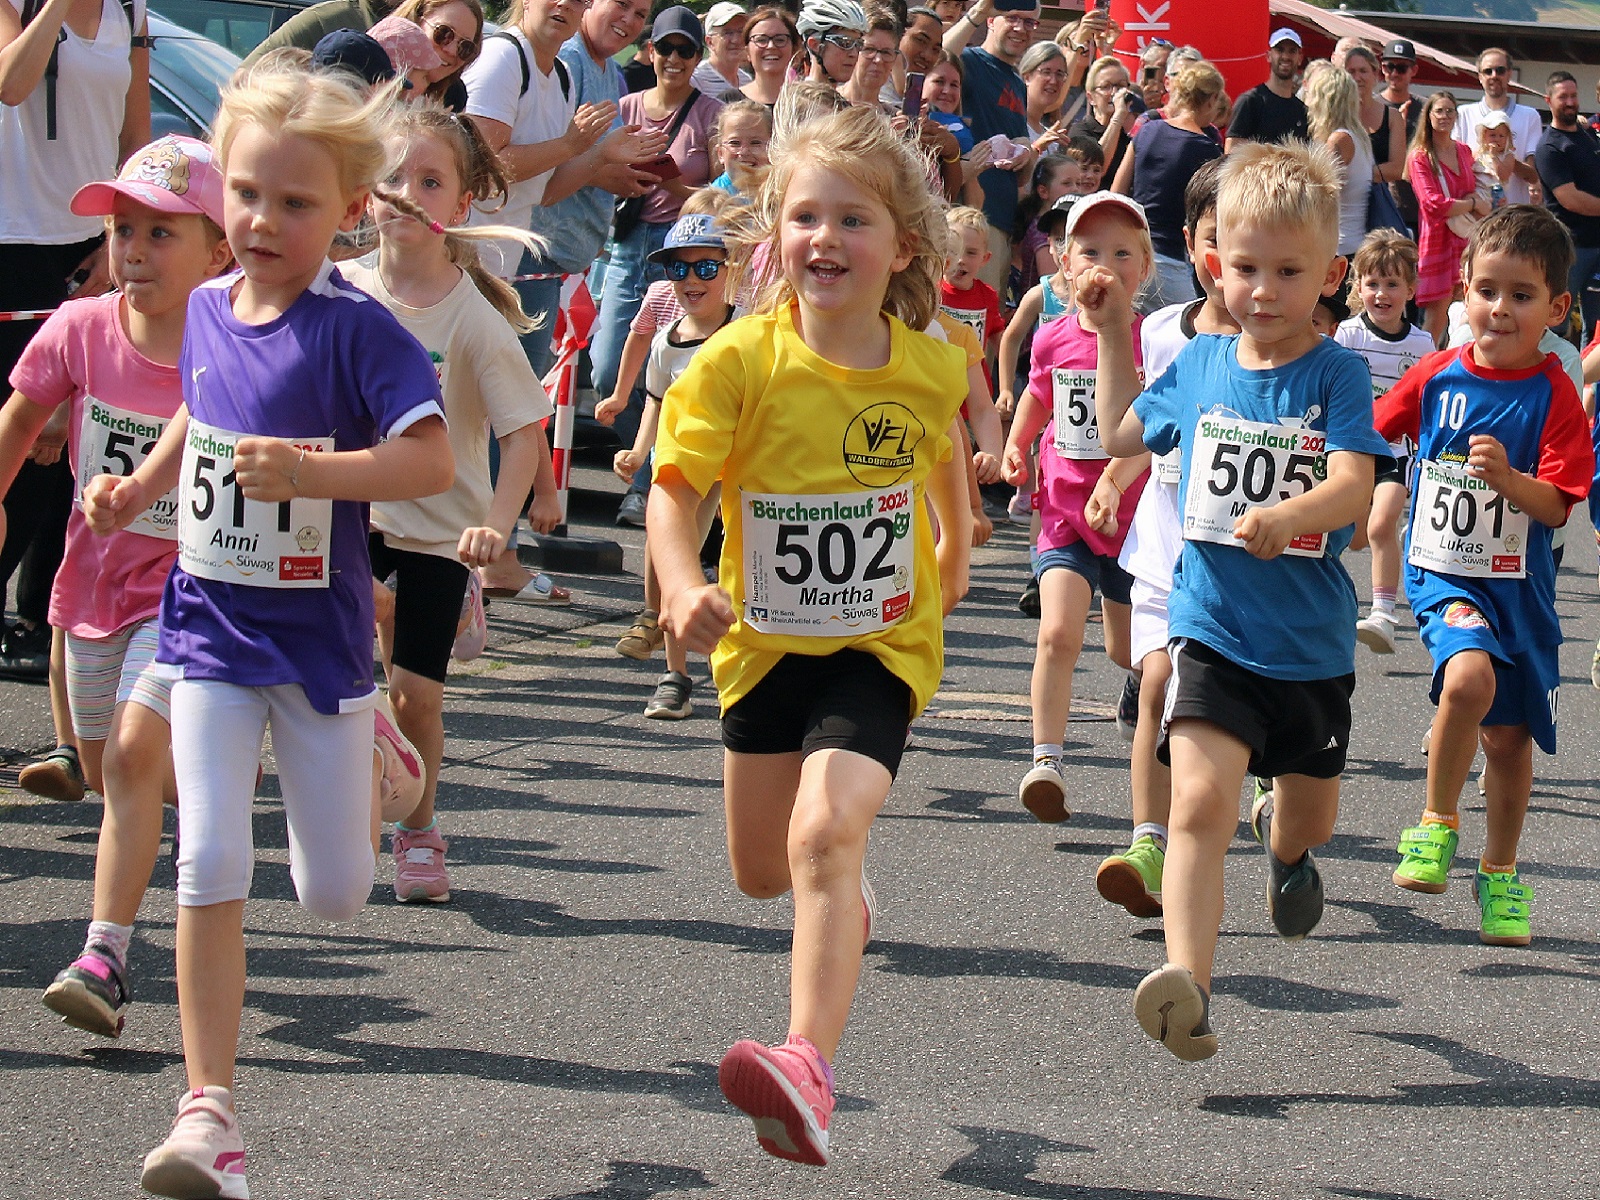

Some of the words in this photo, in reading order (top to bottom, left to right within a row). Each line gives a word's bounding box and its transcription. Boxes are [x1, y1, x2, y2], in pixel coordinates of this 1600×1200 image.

[1438, 390, 1468, 431] 10
[1202, 420, 1298, 451] Bärchenlauf
[102, 430, 159, 477] 5
[847, 453, 912, 467] WALDBREITBACH
[1207, 442, 1316, 503] 505
[1426, 466, 1494, 491] Bärchenlau
[753, 497, 874, 523] Bärchenlauf
[877, 488, 909, 513] 2024
[1430, 485, 1505, 539] 501
[210, 528, 260, 553] Anni
[774, 516, 896, 585] 502
[1439, 535, 1485, 555] Lukas
[236, 555, 275, 573] Süwag
[1461, 554, 1490, 567] Süwag
[799, 587, 874, 606] Martha
[842, 606, 879, 621] Süwag
